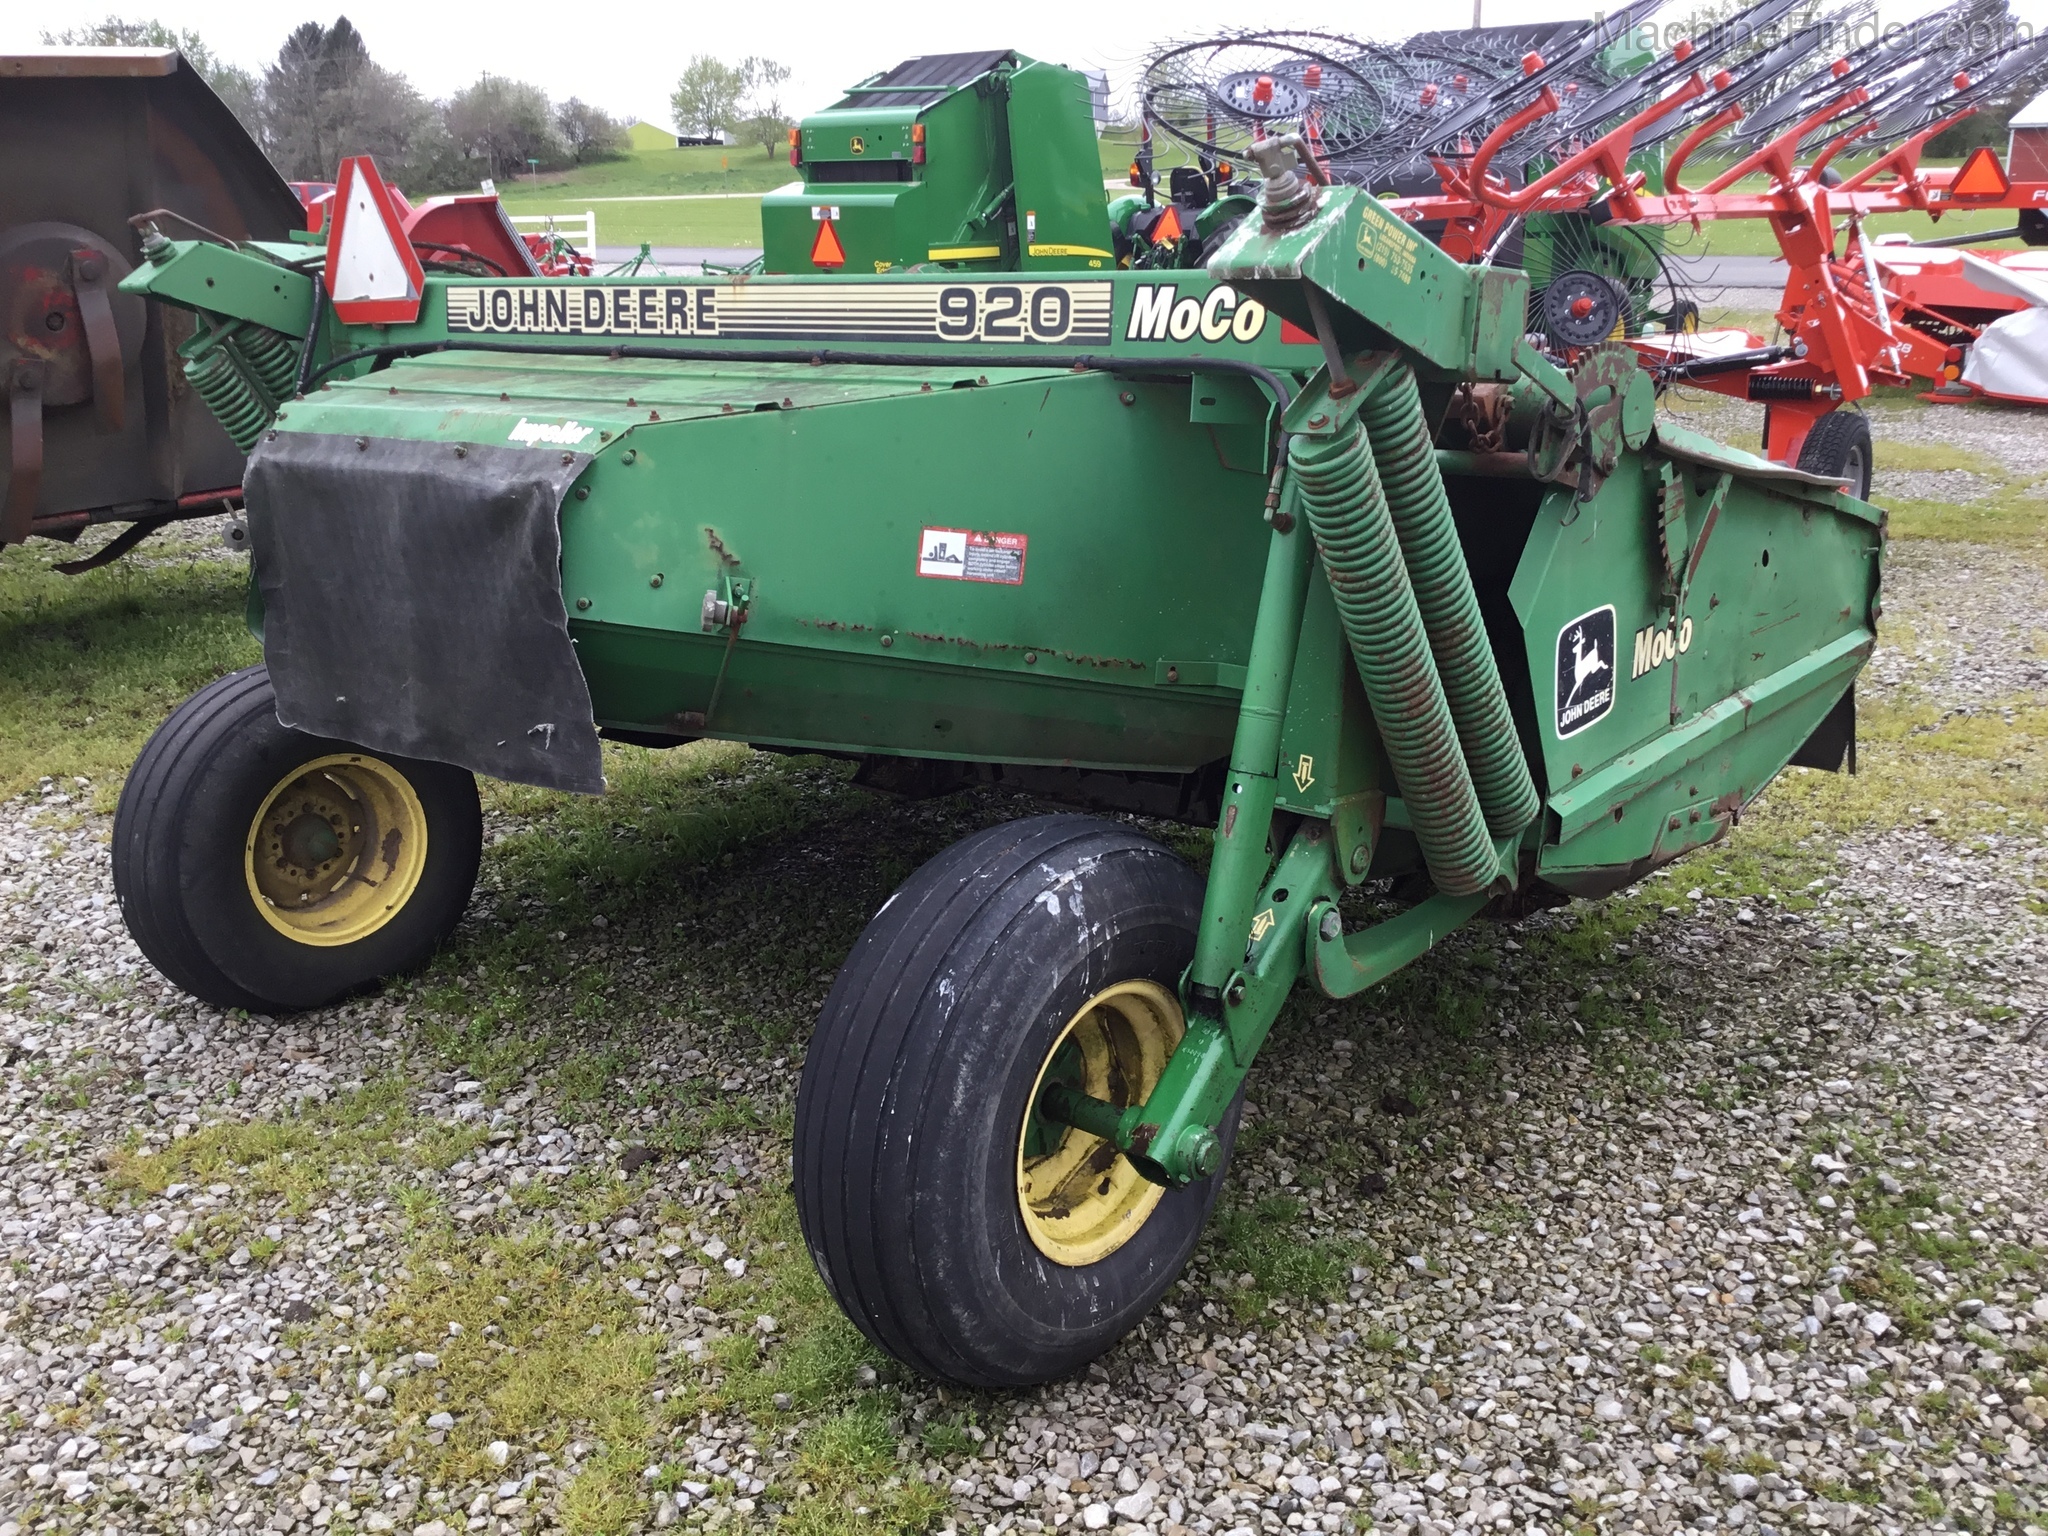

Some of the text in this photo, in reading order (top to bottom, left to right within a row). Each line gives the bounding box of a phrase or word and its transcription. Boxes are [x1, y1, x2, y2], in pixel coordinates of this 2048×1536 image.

[1362, 206, 1385, 230] GREEN
[1383, 222, 1407, 246] POWER
[1033, 247, 1068, 257] JOHN DEERE
[1088, 260, 1102, 268] 459
[467, 288, 719, 335] JOHN DEERE
[936, 286, 1073, 342] 920
[1125, 283, 1268, 342] MoCo
[507, 417, 594, 447] Impeller
[984, 535, 1018, 546] DNGER
[1560, 687, 1611, 728] JOHN DEERE
